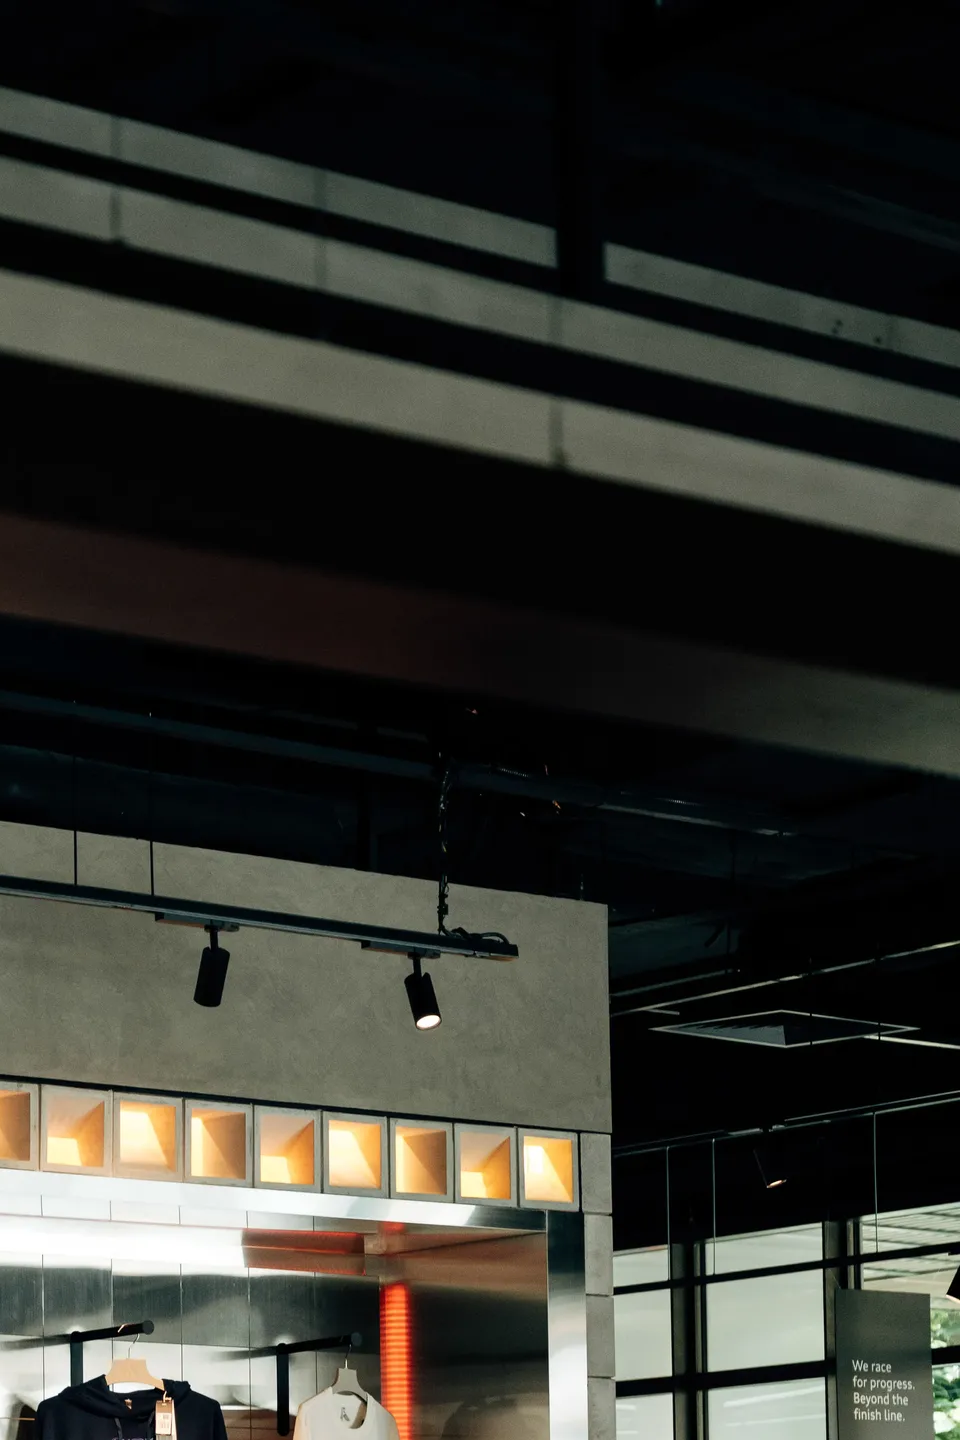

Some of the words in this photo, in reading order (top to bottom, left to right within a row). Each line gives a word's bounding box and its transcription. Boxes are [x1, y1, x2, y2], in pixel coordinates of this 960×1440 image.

[851, 1359, 869, 1372] We
[871, 1362, 892, 1373] race
[853, 1375, 868, 1388] for
[870, 1379, 915, 1392] progress.
[853, 1392, 890, 1408] Beyond
[892, 1393, 909, 1406] the
[853, 1407, 882, 1421] finish
[884, 1408, 906, 1422] line.
